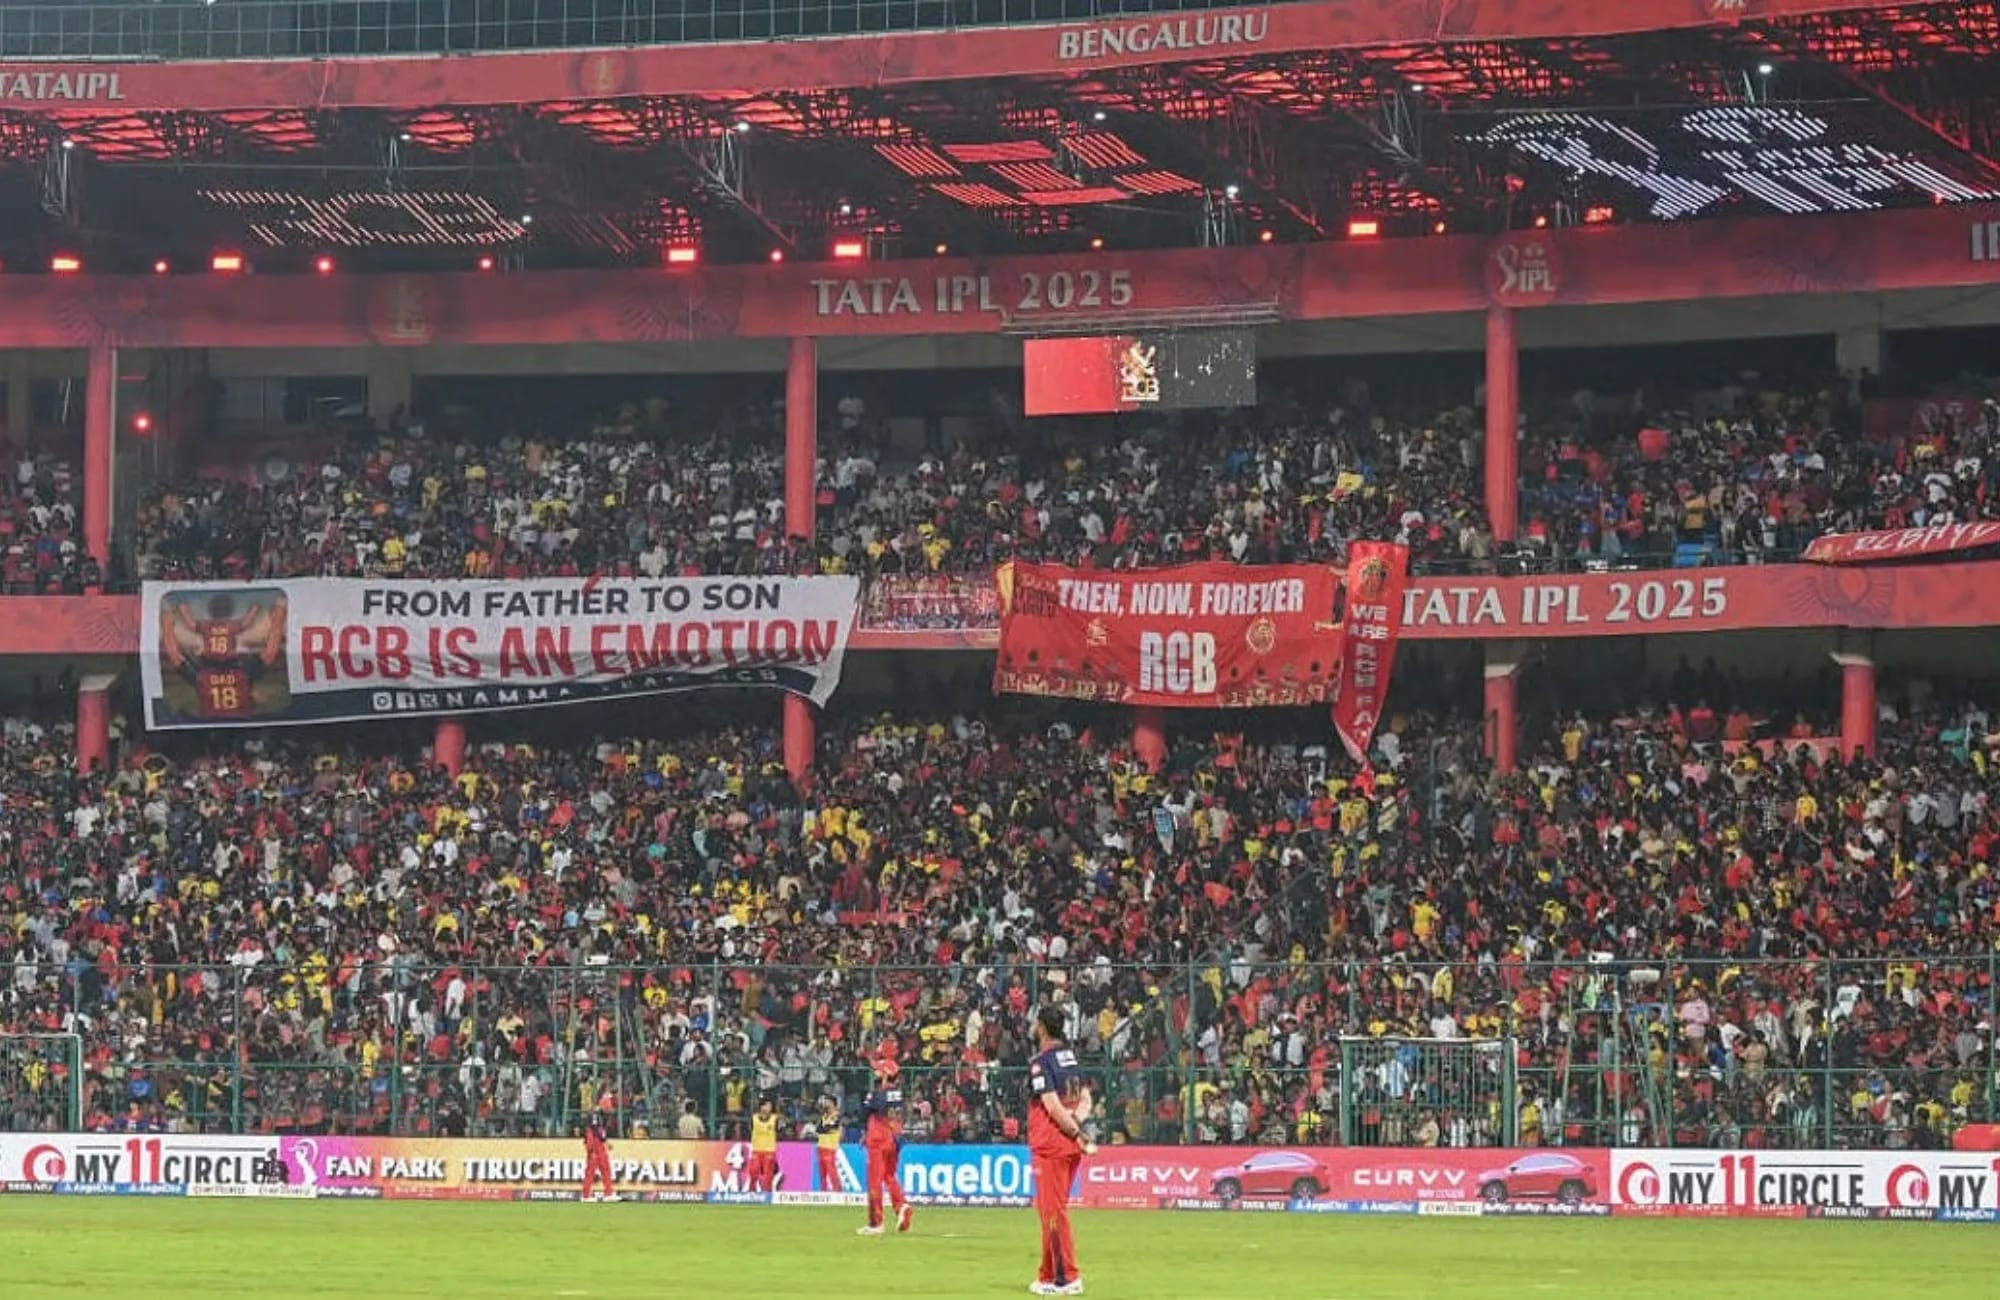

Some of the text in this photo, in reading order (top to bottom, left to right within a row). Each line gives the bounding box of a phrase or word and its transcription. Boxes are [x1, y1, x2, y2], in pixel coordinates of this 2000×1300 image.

[1059, 12, 1269, 59] BENGALURU
[810, 268, 1134, 315] TATA IPL 2025
[1520, 269, 1557, 292] IPL
[362, 583, 781, 618] FROM FATHER TO SON
[1058, 579, 1123, 617] THEN,
[1130, 580, 1194, 617] NOW,
[1200, 578, 1304, 615] FOREVER
[1351, 603, 1389, 621] WE
[1402, 577, 1727, 625] TATA IPL 2025
[1348, 625, 1389, 640] ARE
[301, 619, 838, 682] RCB IS AN EMOTION
[1139, 631, 1217, 694] RCB
[211, 686, 239, 710] 18
[325, 1155, 695, 1182] FAN PARK TIRUCHIRPPALLI
[1088, 1166, 1200, 1182] CURVV
[1354, 1169, 1466, 1185] CURVV
